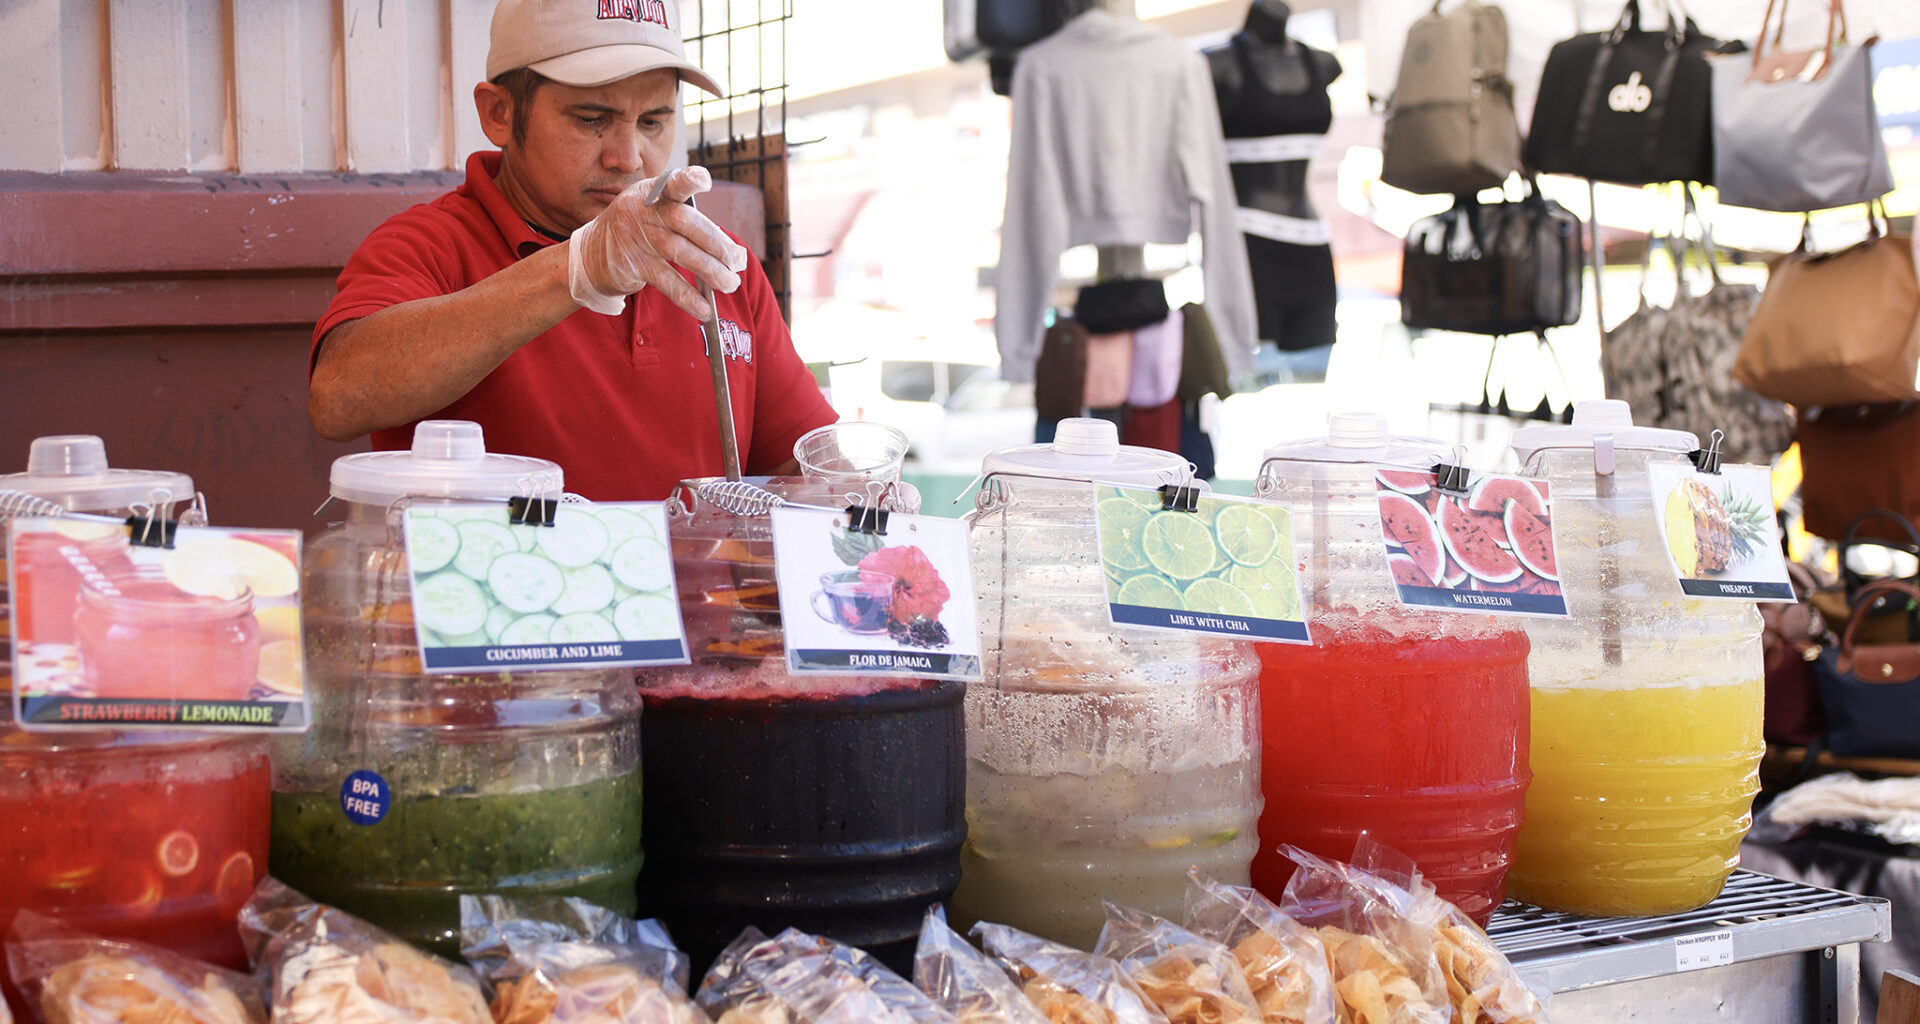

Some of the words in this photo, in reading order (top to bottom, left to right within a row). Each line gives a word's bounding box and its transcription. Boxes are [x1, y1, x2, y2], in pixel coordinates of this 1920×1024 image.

[1719, 584, 1754, 594] PINEAPPLE
[1453, 594, 1512, 607] WATERMELON
[1170, 614, 1195, 626] LIME
[1196, 617, 1224, 629] WITH
[1225, 620, 1250, 631] CHIA
[486, 647, 559, 661] CUCUMBER
[561, 646, 589, 658] AND
[591, 644, 623, 657] LIME
[849, 654, 877, 666] FLOR
[878, 655, 893, 666] DE
[893, 655, 932, 668] JAMAICA
[60, 703, 179, 721] STRAWBERRY
[182, 705, 273, 723] LEMONADE
[352, 778, 380, 798] BPA
[346, 796, 381, 818] FREE
